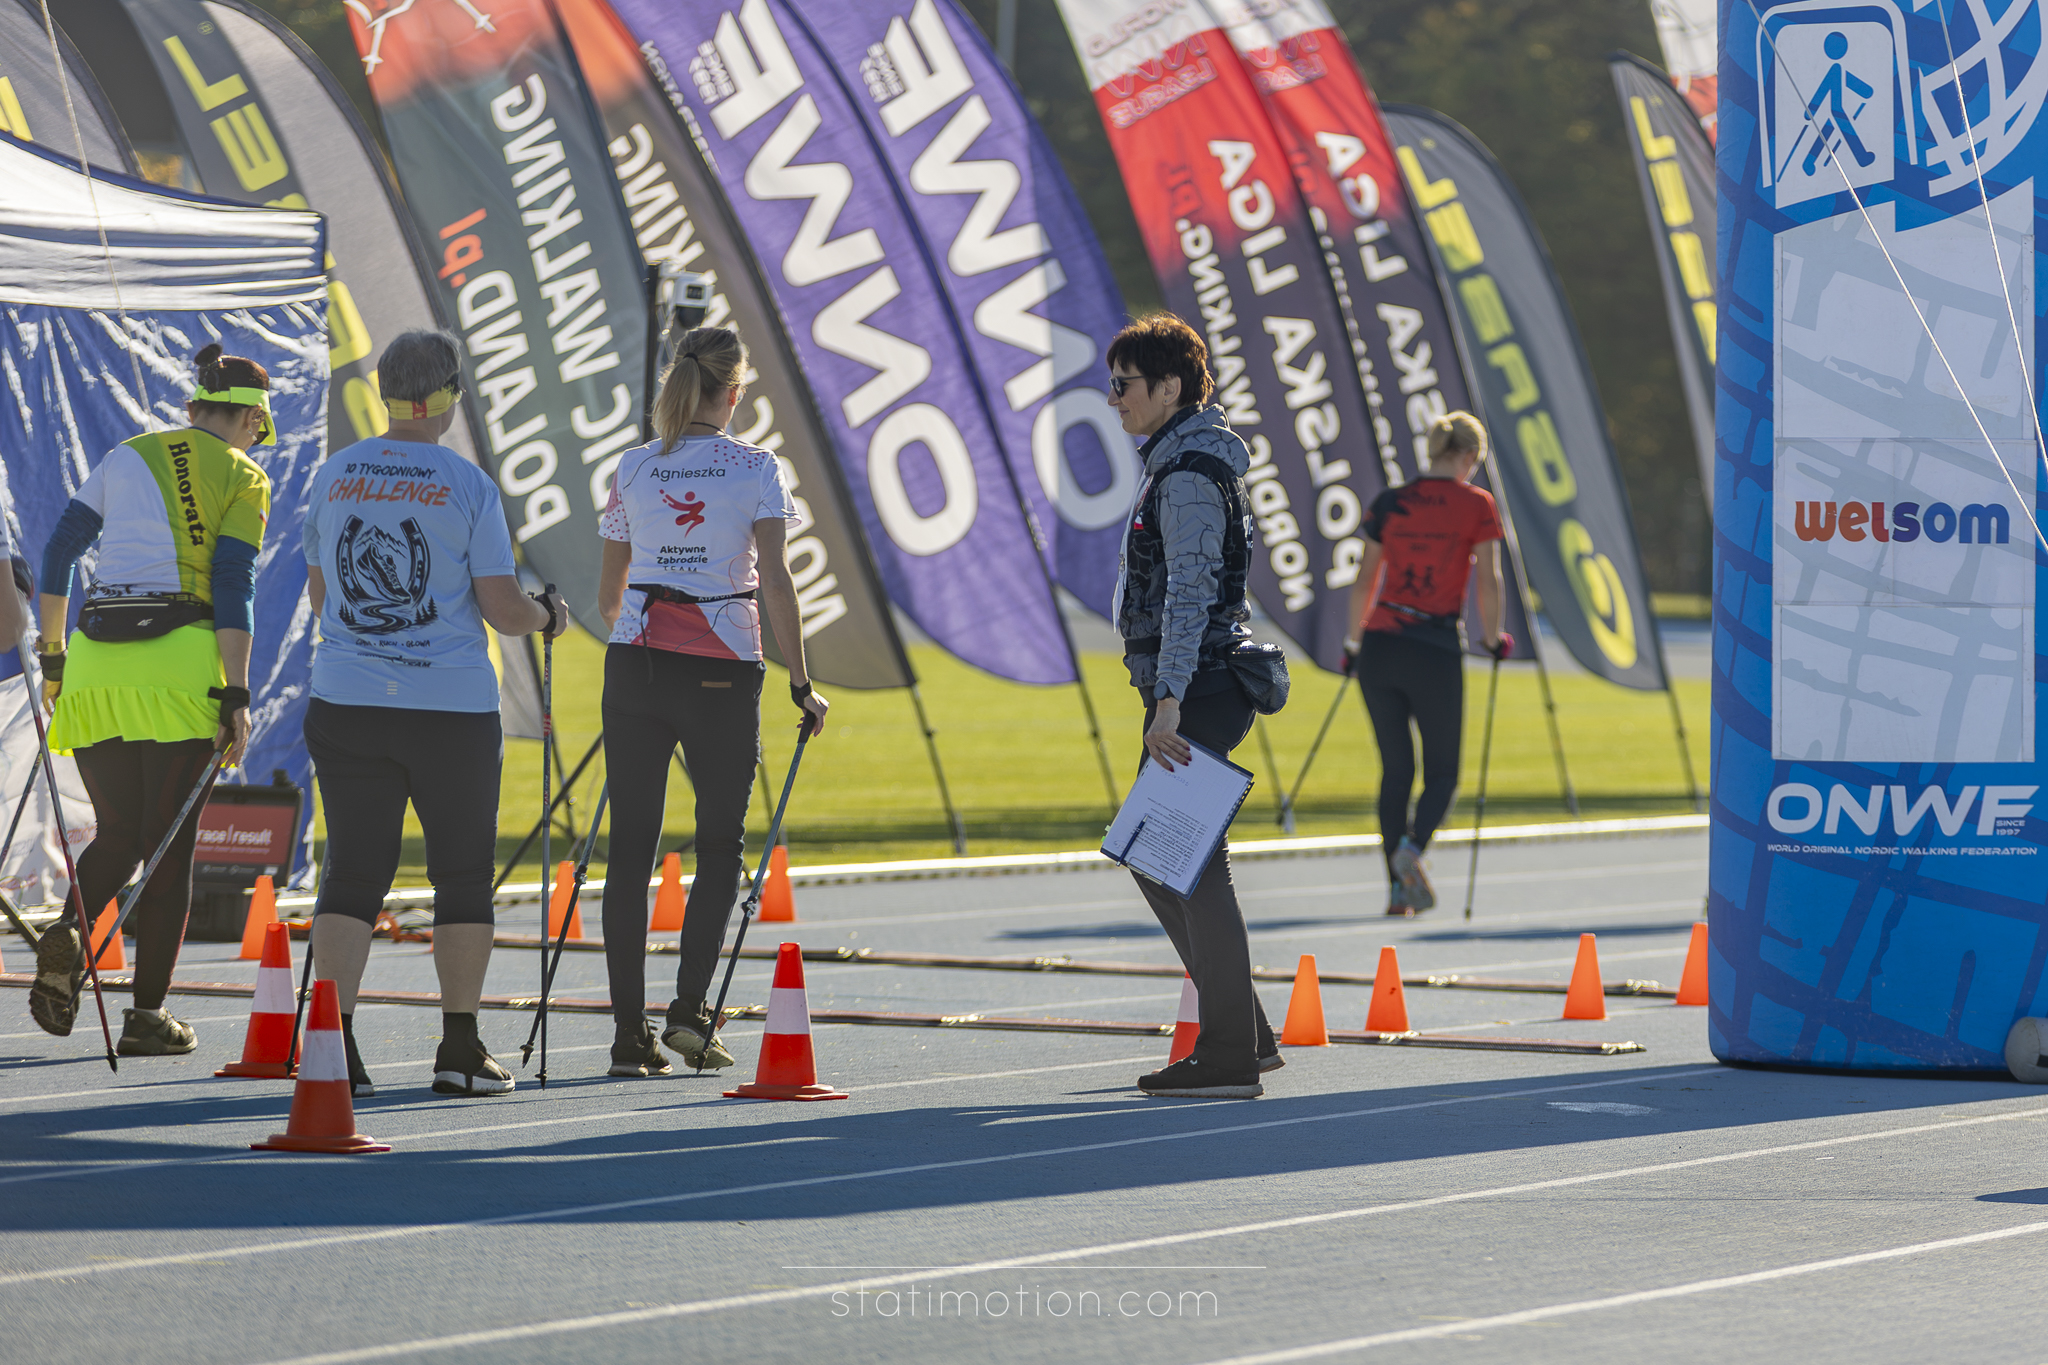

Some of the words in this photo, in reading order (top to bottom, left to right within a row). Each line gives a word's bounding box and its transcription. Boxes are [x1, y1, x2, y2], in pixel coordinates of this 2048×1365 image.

[344, 463, 354, 475] 10
[359, 463, 437, 480] TYGODNIOWY
[650, 467, 726, 482] Agnieszka
[167, 440, 208, 547] Honorata
[329, 477, 451, 506] CHALLENGE
[1794, 500, 2010, 545] welsom
[659, 545, 707, 556] Aktywne
[656, 554, 708, 565] Zabrodzie
[1766, 782, 2041, 837] ONWF
[1996, 819, 2026, 827] SINCE
[1996, 828, 2021, 836] 1997
[1767, 843, 1800, 853] WORLD
[1802, 844, 1852, 854] ORIGINAL
[1854, 846, 1899, 855] NORDIC
[1902, 847, 1958, 856] WALKING
[1960, 846, 2038, 856] FEDERATION
